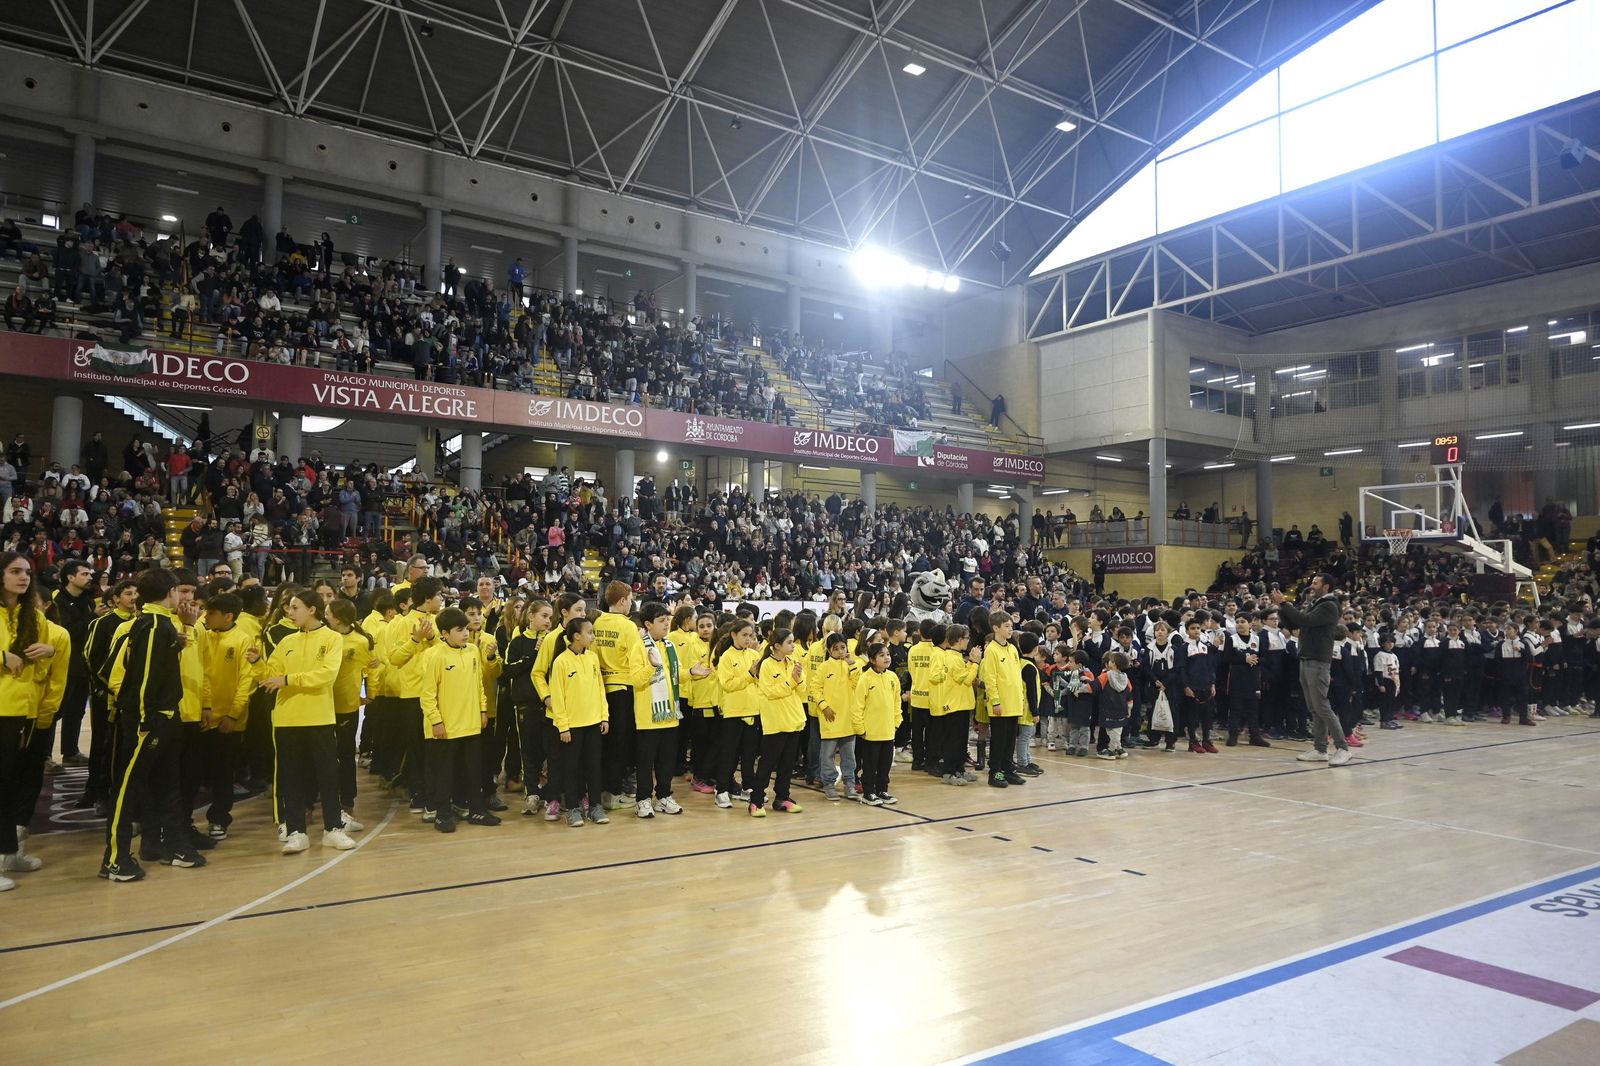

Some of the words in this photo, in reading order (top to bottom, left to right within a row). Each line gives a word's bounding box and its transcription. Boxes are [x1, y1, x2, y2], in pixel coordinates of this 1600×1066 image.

[147, 352, 249, 383] MDECO
[74, 371, 111, 382] Instituto
[113, 375, 157, 387] Municipal
[159, 380, 170, 388] de
[172, 381, 211, 392] Deportes
[324, 373, 367, 386] PALACIO
[368, 378, 419, 392] MUNICIPAL
[422, 385, 466, 397] DEPORTES
[312, 383, 381, 409] VISTA
[388, 392, 478, 418] ALEGRE
[556, 400, 643, 427] IMDECO
[528, 419, 553, 428] Instituto
[553, 422, 583, 432] Municipal
[591, 426, 618, 436] Deportes
[705, 423, 744, 434] AYUNTAMIENTO
[705, 431, 713, 439] DE
[814, 432, 879, 454] IMDECO
[937, 451, 968, 462] Diputación
[1447, 447, 1458, 462] 0
[683, 461, 689, 469] D
[946, 461, 969, 469] Córdoba
[1004, 457, 1044, 472] IMDECO
[1107, 552, 1153, 565] IMDECO
